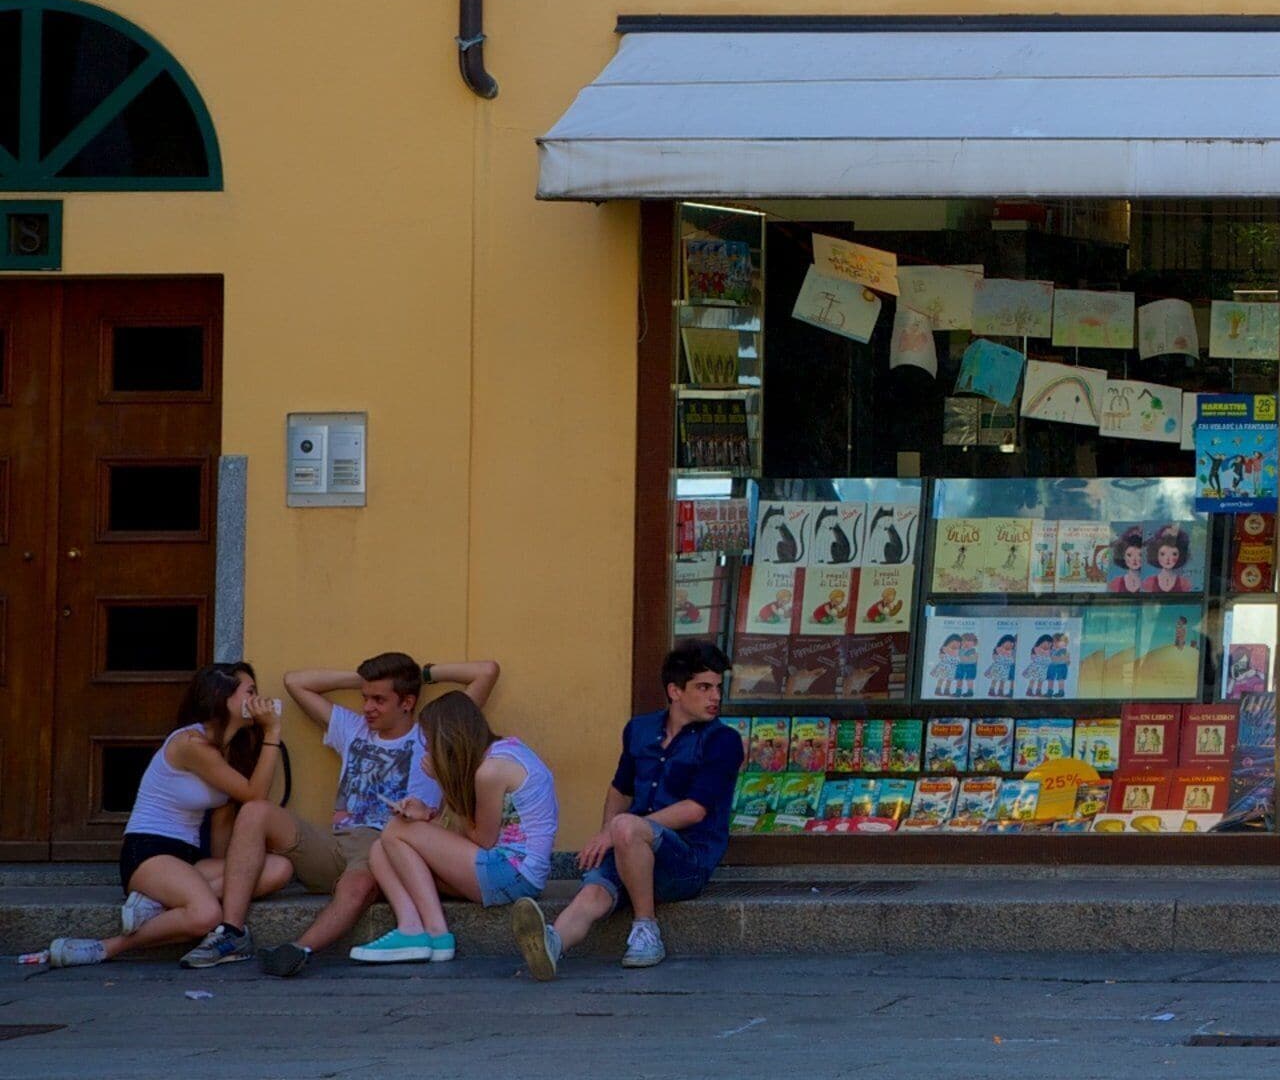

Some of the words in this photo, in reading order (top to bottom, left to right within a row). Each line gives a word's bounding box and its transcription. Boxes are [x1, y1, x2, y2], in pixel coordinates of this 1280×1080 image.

[19, 218, 40, 252] 8
[1098, 750, 1109, 760] 25
[1045, 774, 1082, 791] 25%
